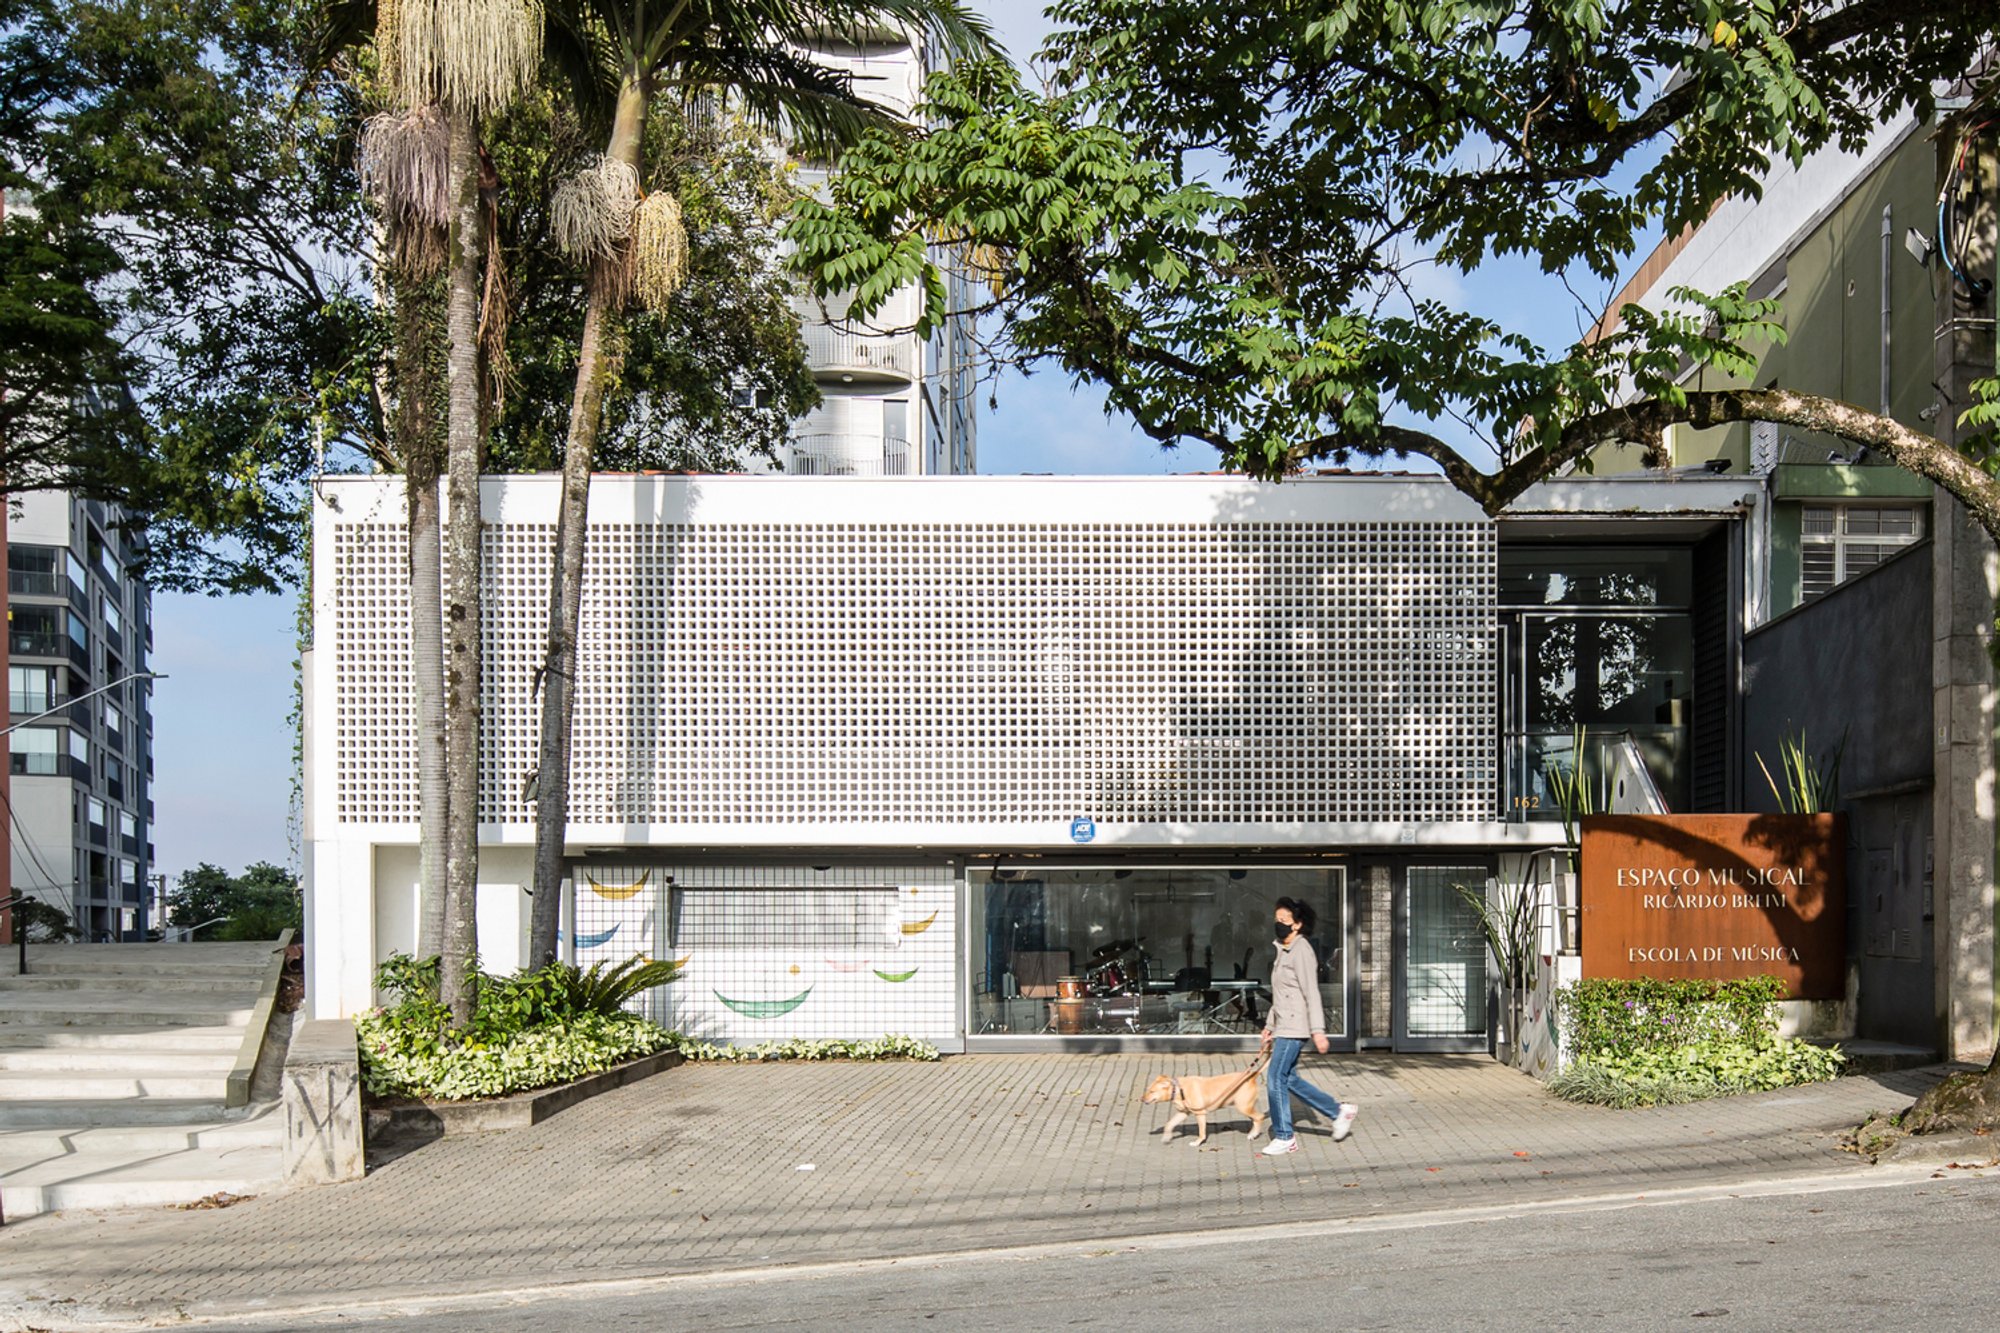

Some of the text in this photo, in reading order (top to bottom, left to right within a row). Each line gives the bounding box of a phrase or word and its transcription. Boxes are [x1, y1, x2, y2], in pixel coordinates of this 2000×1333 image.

[1514, 795, 1540, 809] 162
[1617, 867, 1812, 889] ESPAÇO MUSICAL
[1643, 894, 1727, 909] RICARDO
[1628, 943, 1800, 963] ESCOLA DE MÚSICA
